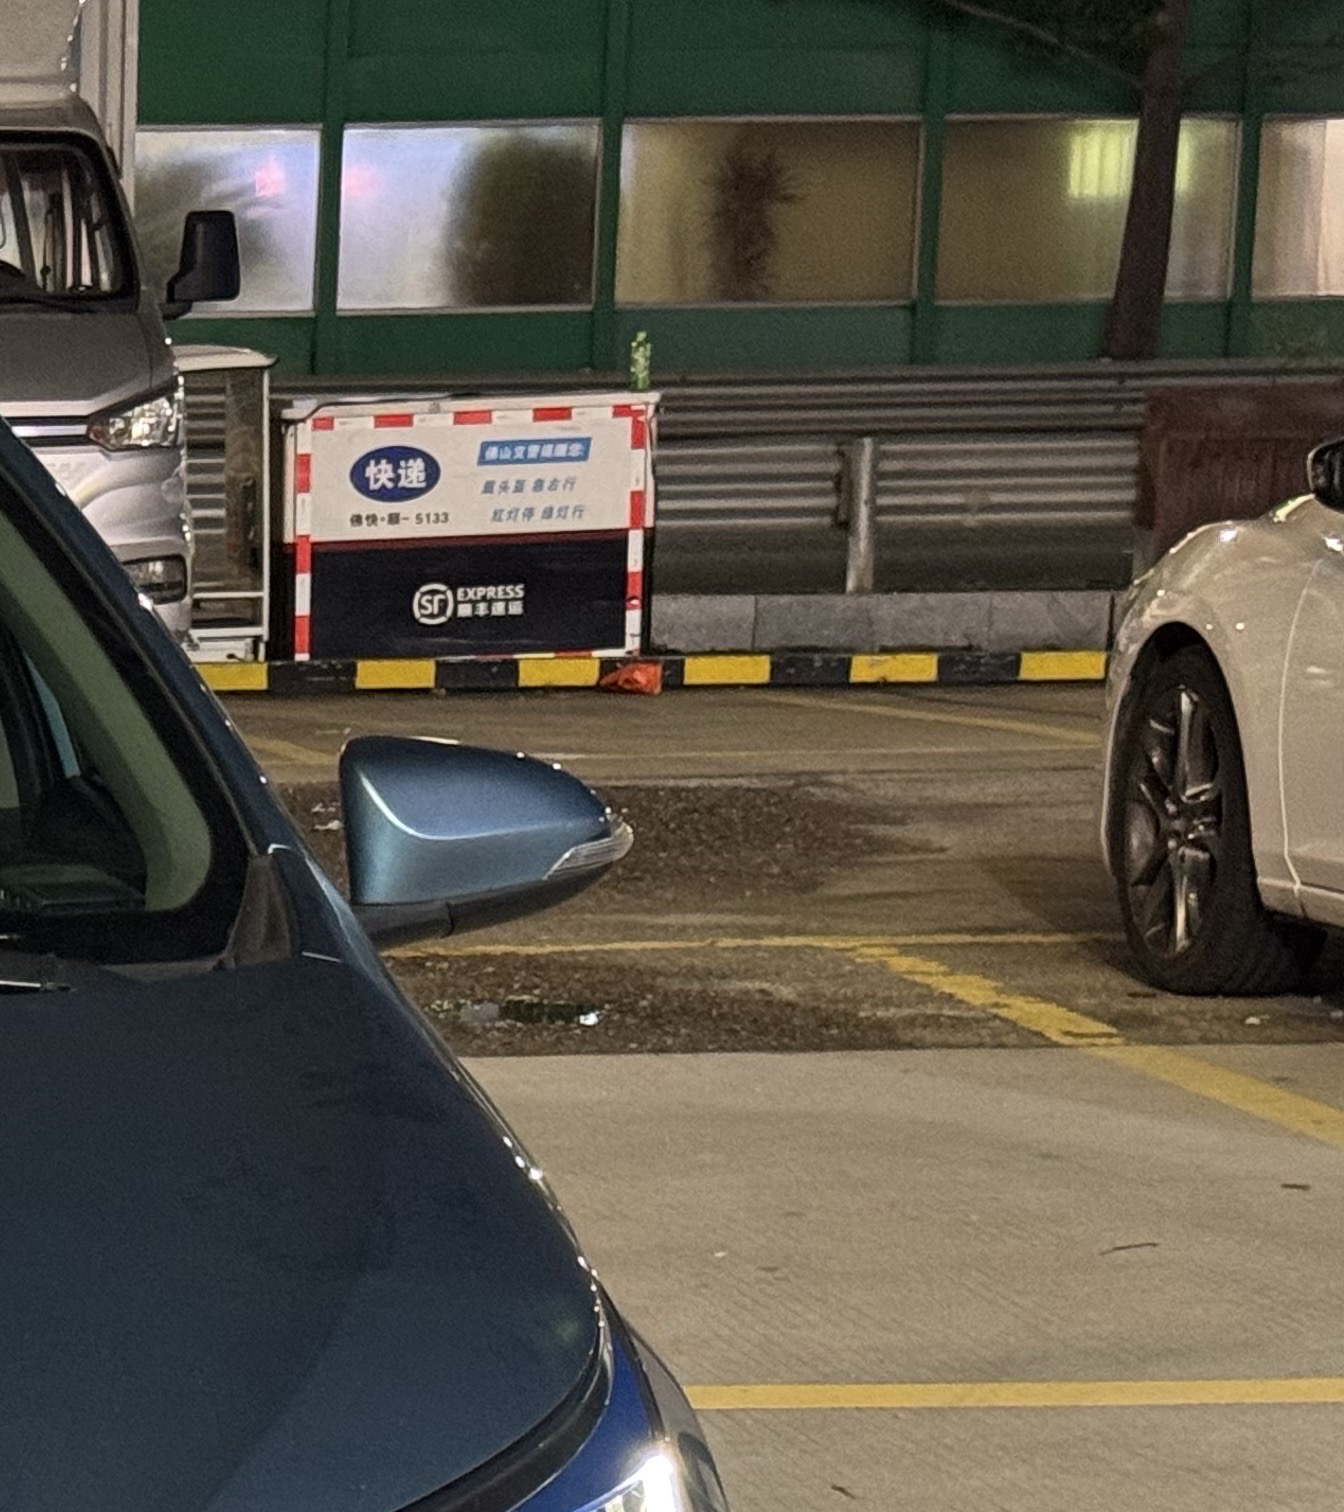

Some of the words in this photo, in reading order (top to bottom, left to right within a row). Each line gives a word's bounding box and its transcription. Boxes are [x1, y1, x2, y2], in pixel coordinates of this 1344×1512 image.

[364, 457, 427, 491] 快递
[414, 511, 450, 526] 5133
[456, 583, 525, 602] EXPRESS
